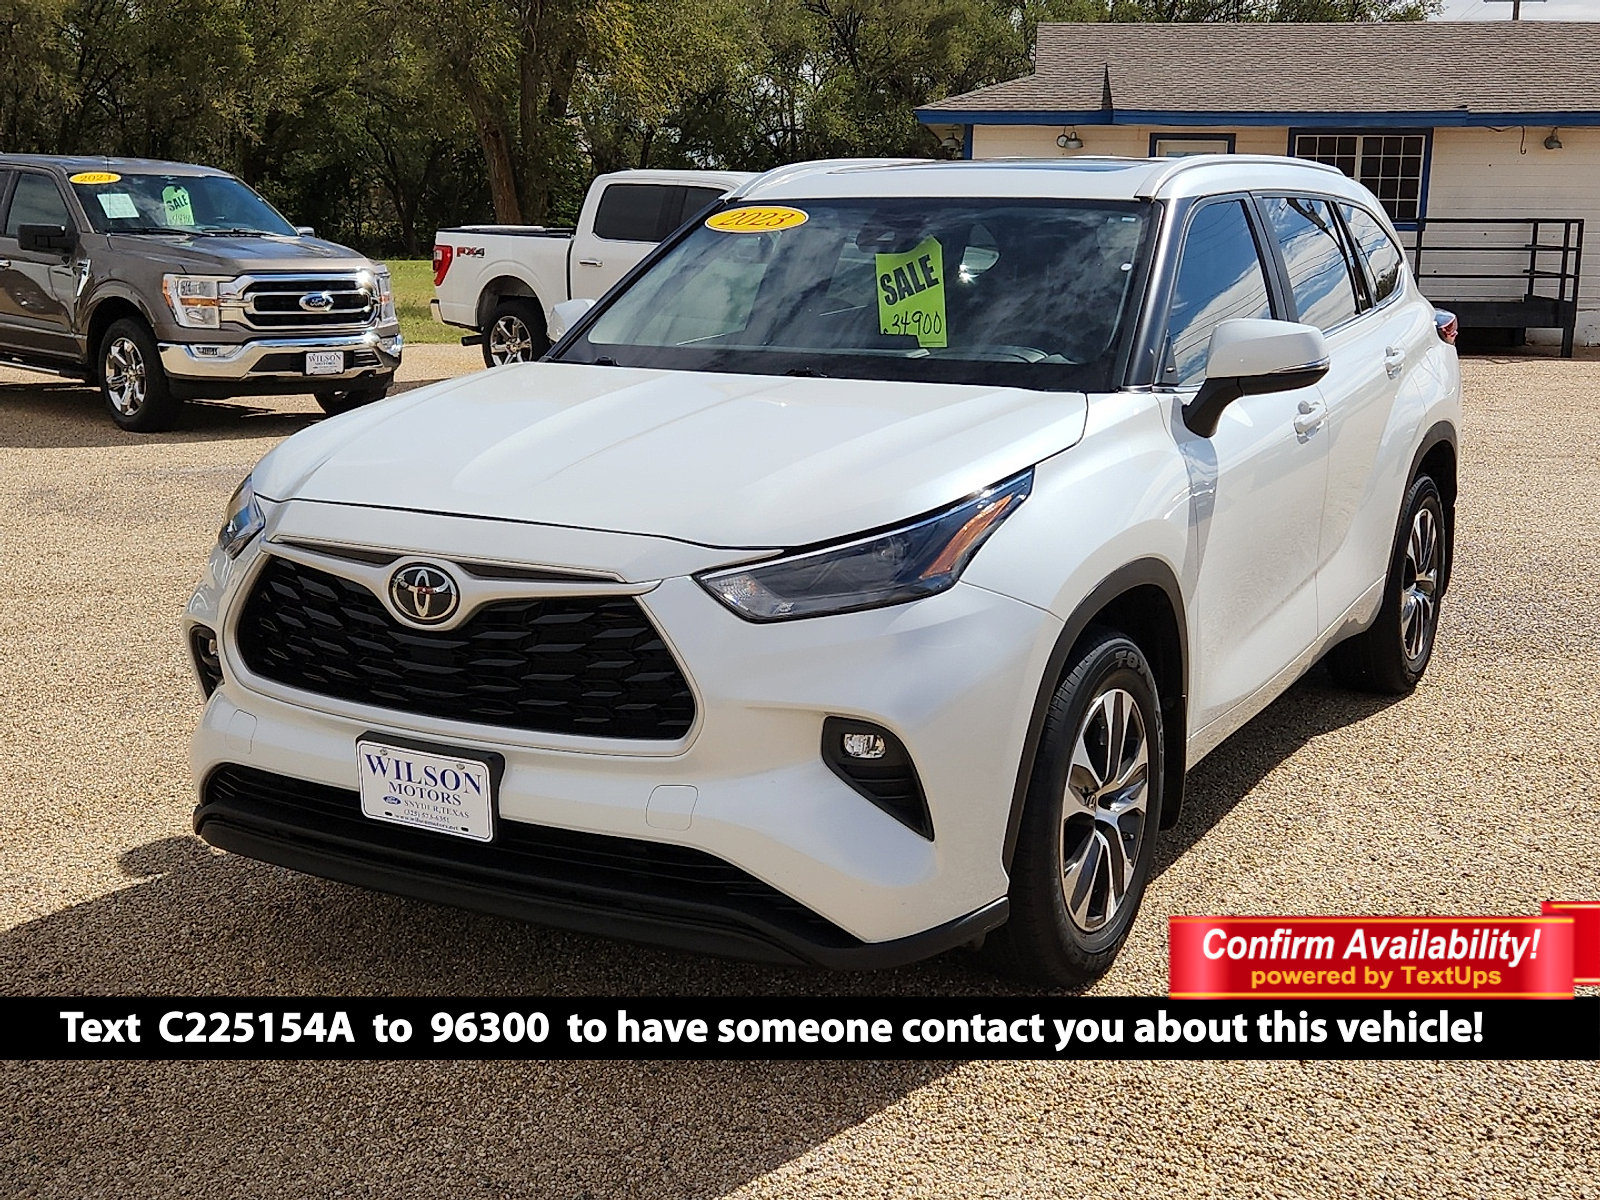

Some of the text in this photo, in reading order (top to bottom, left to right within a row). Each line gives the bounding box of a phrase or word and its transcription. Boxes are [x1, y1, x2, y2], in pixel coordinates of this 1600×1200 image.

[166, 194, 188, 212] SALE
[718, 212, 796, 227] 2023
[456, 246, 485, 257] FX4
[880, 255, 940, 306] SALE
[365, 754, 482, 796] WILSON
[388, 781, 462, 806] MOTORS
